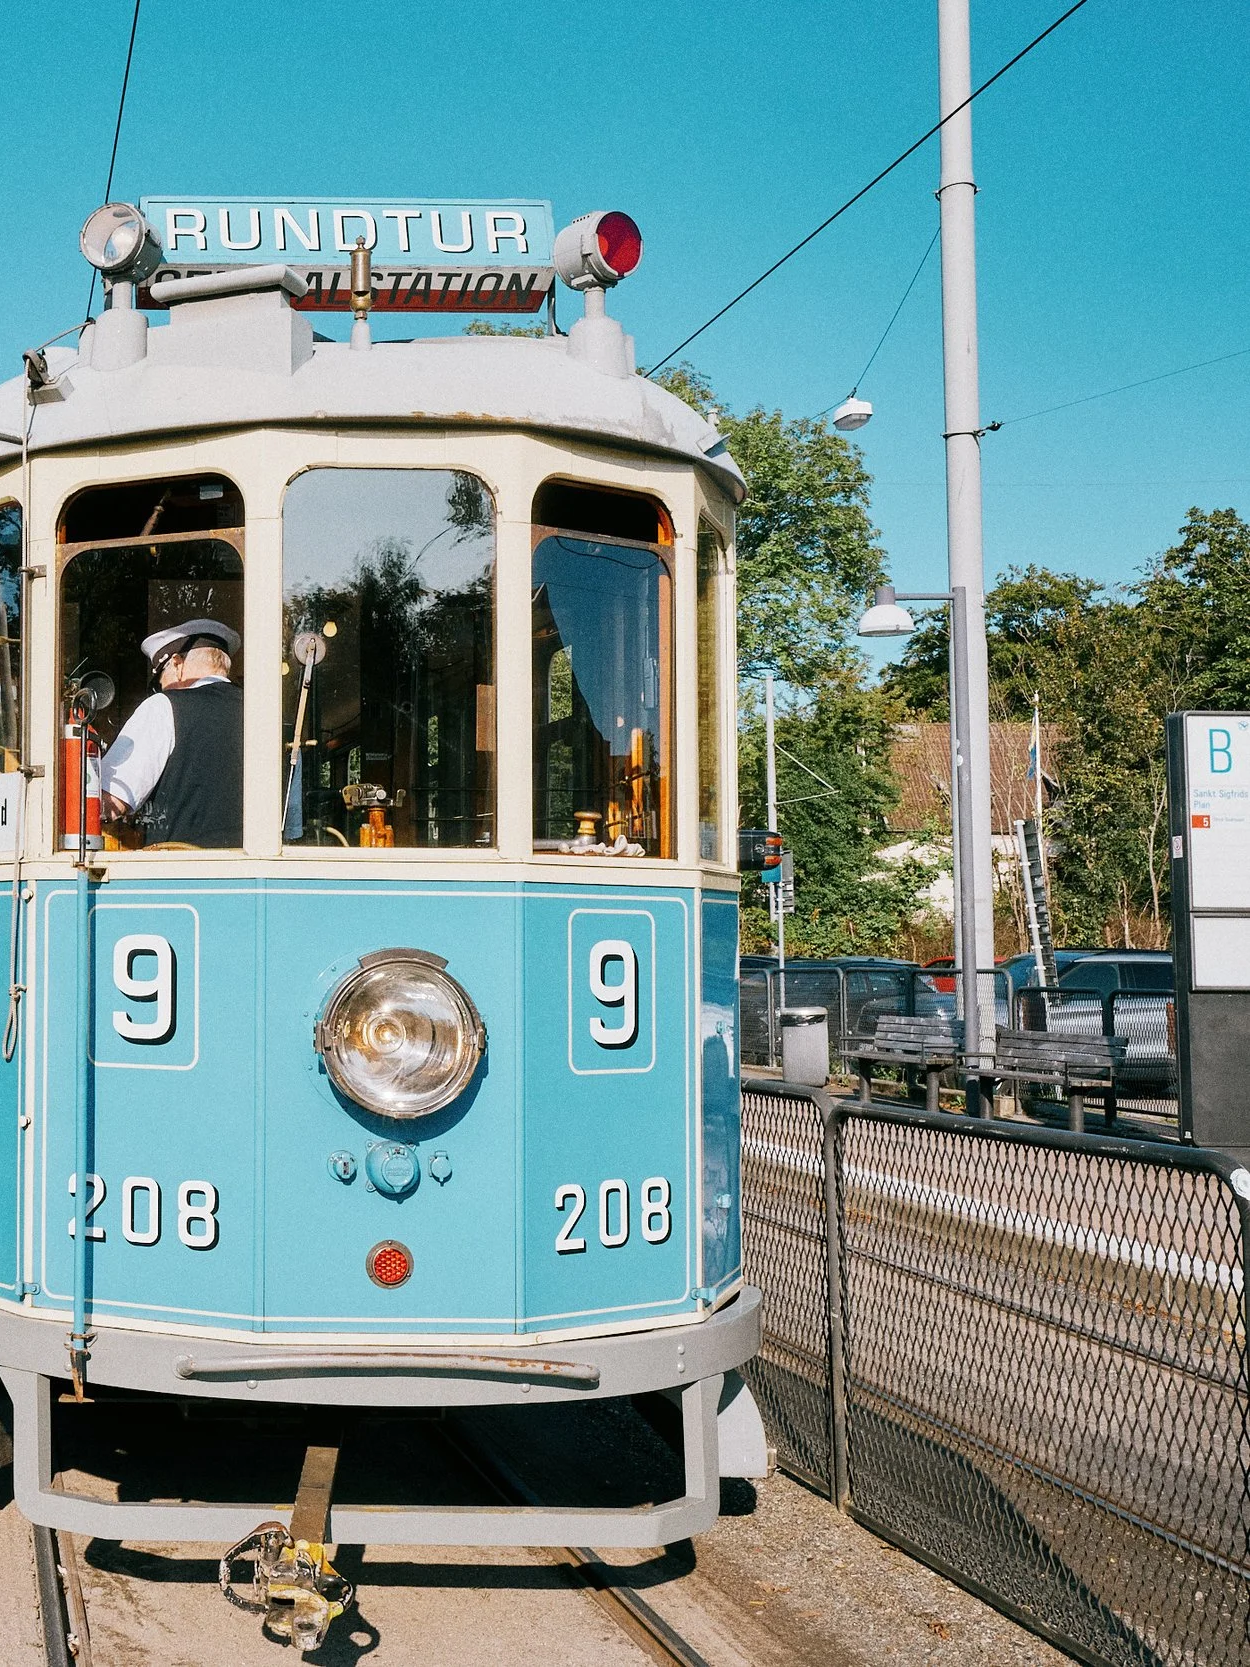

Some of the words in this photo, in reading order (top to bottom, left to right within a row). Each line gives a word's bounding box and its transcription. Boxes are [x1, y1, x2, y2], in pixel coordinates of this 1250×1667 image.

[165, 207, 530, 256] RUNDTUR
[1209, 728, 1232, 773] B
[1193, 789, 1216, 798] Sankt
[1219, 789, 1249, 800] Sigfrids
[1193, 800, 1211, 809] Plan
[1203, 816, 1210, 827] 5
[112, 933, 177, 1044] 9
[588, 939, 639, 1048] 9
[68, 1172, 220, 1252] 208
[554, 1176, 673, 1254] 208
